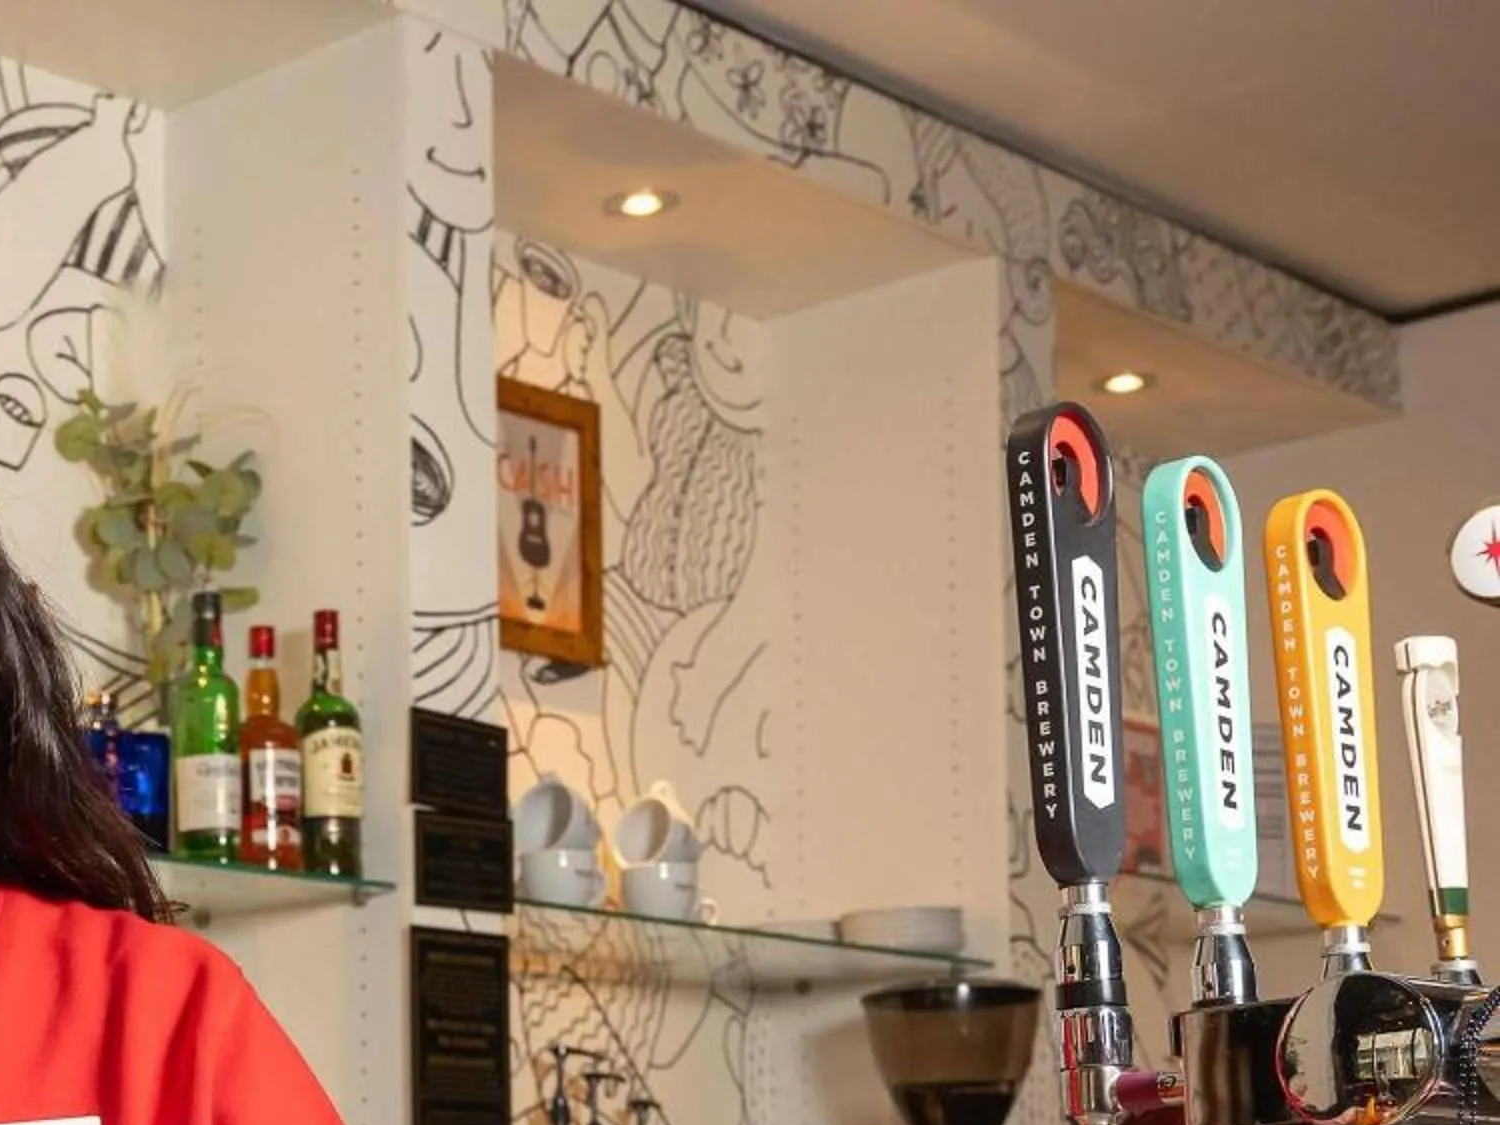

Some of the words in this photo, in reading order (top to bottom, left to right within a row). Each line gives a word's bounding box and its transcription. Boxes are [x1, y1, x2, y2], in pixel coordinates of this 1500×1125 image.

[1017, 451, 1039, 568] CAMDEN
[1154, 511, 1174, 623] CAMDEN
[1029, 584, 1047, 663] TOWN
[1275, 545, 1297, 652] CAMDEN
[1080, 575, 1107, 785] CAMDEN
[1164, 639, 1182, 713] TOWN
[1211, 611, 1238, 810] CAMDEN
[1287, 667, 1306, 737] TOWN
[1035, 680, 1058, 819] BREWERY
[1172, 728, 1195, 860] BREWERY
[1333, 645, 1363, 831] CAMDEN
[1295, 753, 1320, 879] BREWERY
